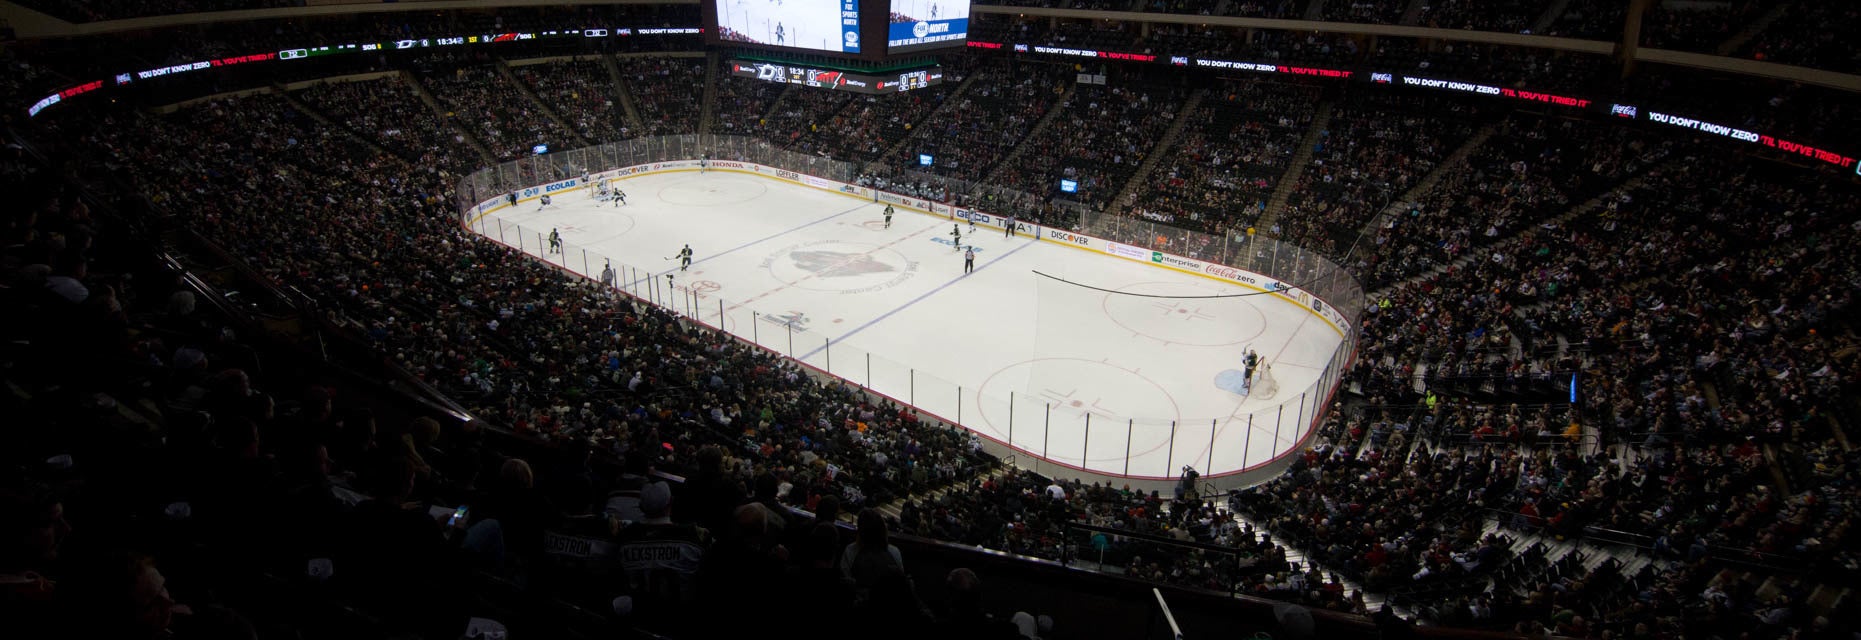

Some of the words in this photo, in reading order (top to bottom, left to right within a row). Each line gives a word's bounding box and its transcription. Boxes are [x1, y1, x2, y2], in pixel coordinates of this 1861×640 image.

[138, 70, 152, 79] YOU
[152, 67, 170, 76] DON'T
[172, 63, 192, 73] KNOW
[193, 61, 210, 70] ZERO
[1291, 67, 1318, 76] YOU'VE
[1319, 69, 1341, 77] TRIED
[1403, 77, 1421, 85] YOU
[1421, 79, 1447, 88] DON'T
[1448, 81, 1475, 92] KNOW
[1476, 85, 1500, 95] ZERO
[1518, 91, 1549, 102] YOU'VE
[1551, 95, 1576, 106] TRIED
[1649, 112, 1668, 123] YOU
[1669, 116, 1700, 130] DON'T
[1700, 122, 1731, 136] KNOW
[1731, 129, 1759, 142] ZERO
[1778, 139, 1813, 157] YOU'VE
[1814, 148, 1840, 165] TRIED
[618, 165, 648, 177] DISCOVER
[776, 170, 799, 180] LOFFLER
[546, 180, 576, 192] ECOLAB
[957, 210, 990, 223] GECO
[1051, 231, 1088, 246] DISCOVER
[1152, 252, 1200, 270] enterprise
[1237, 274, 1256, 284] zero
